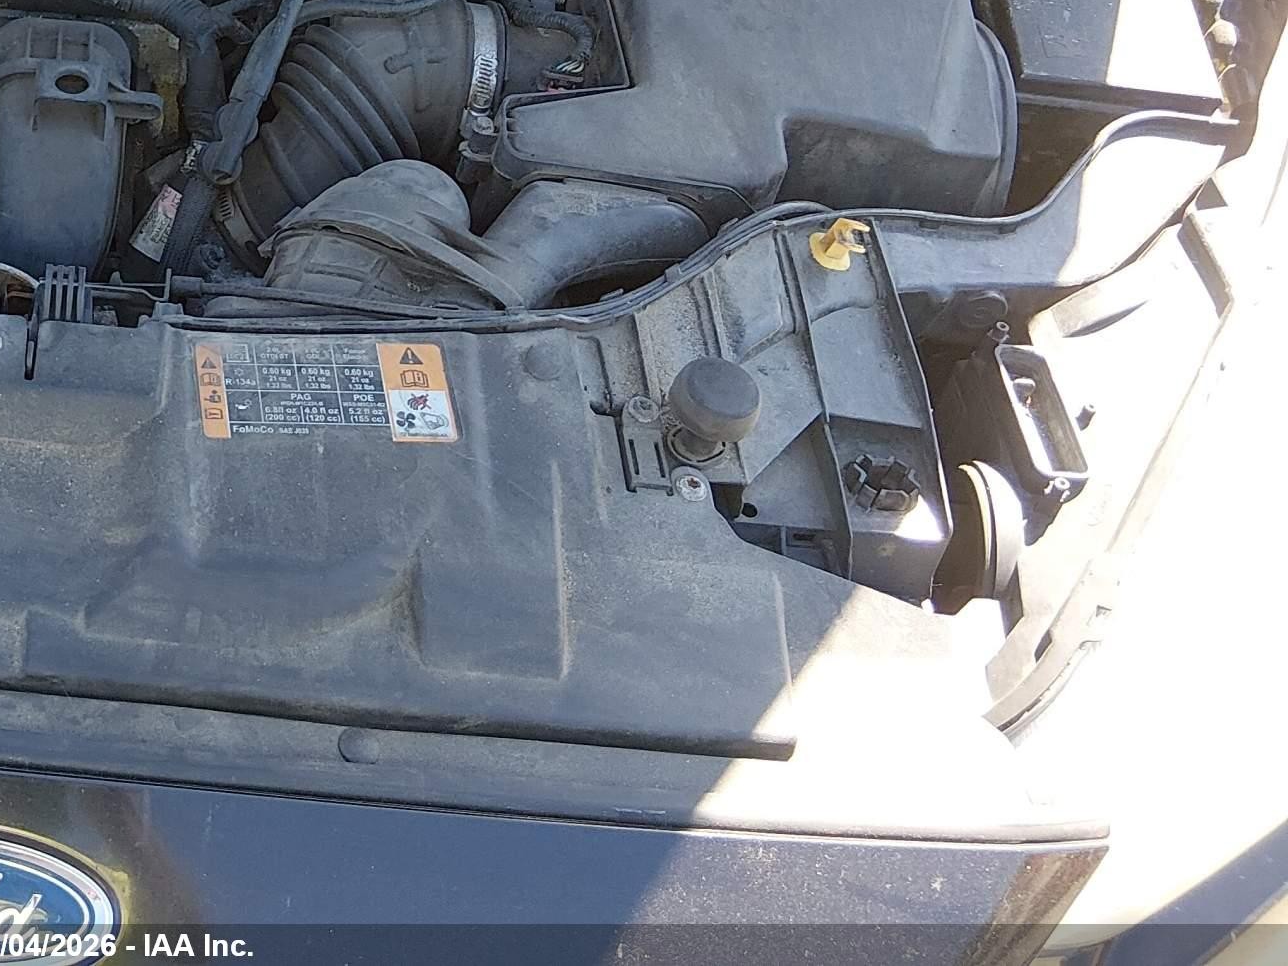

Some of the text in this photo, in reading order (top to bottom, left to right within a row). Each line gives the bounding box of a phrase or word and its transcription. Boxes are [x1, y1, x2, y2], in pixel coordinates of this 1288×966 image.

[281, 367, 292, 376] kg
[319, 368, 331, 376] kg
[363, 369, 374, 378] kg
[290, 393, 312, 401] PAG
[353, 394, 374, 402] POE
[286, 414, 301, 422] cc)
[306, 414, 325, 422] (120
[371, 415, 386, 424] cc)
[233, 425, 274, 434] FoMoCo
